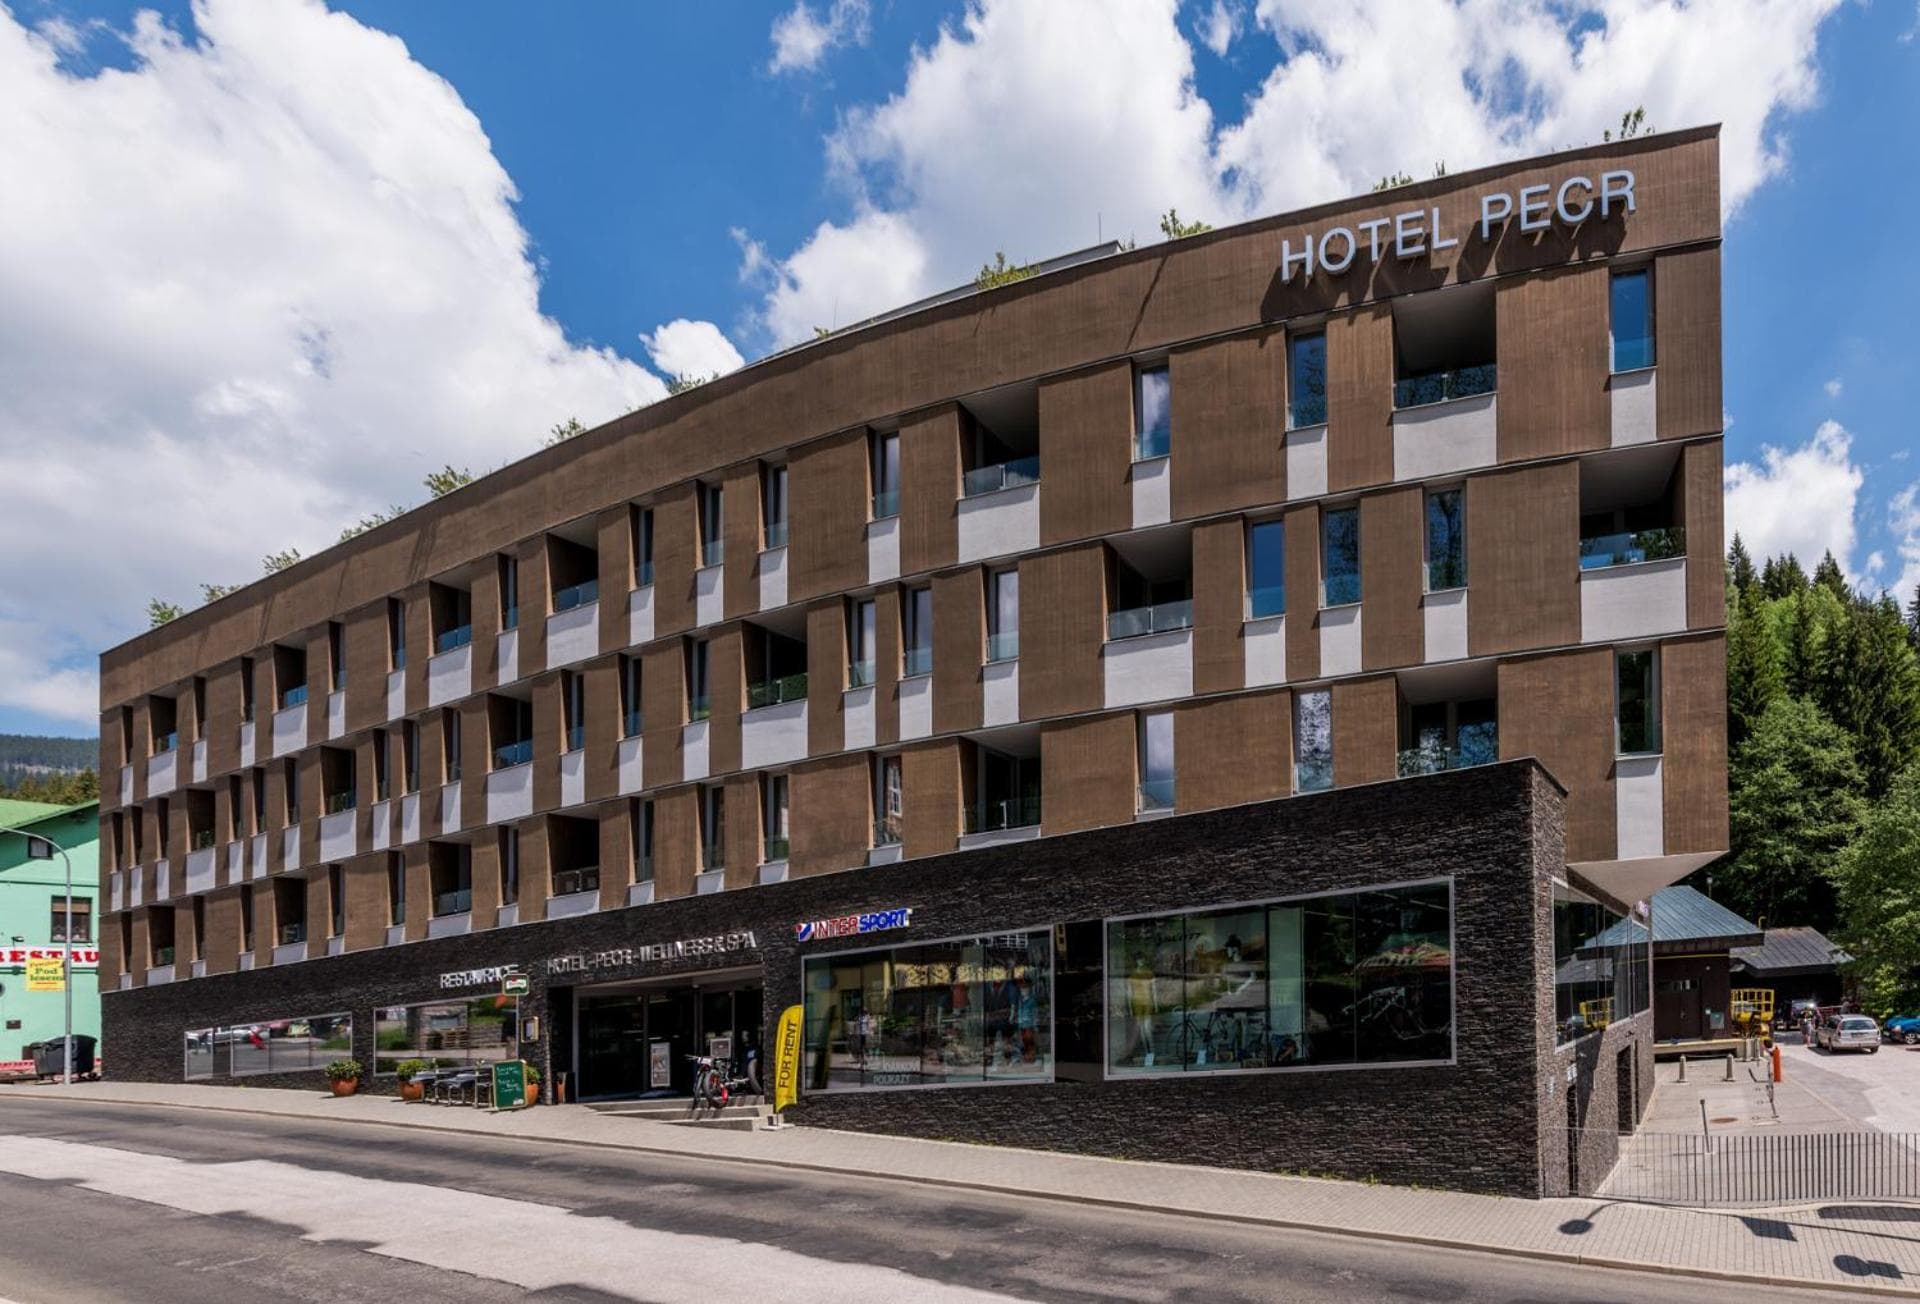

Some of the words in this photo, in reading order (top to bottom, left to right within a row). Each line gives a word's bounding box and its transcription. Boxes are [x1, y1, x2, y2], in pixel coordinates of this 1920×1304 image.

[1281, 207, 1458, 284] HOTEL
[1481, 170, 1637, 243] PECR
[784, 1020, 798, 1057] RENT
[779, 1060, 792, 1089] FOR
